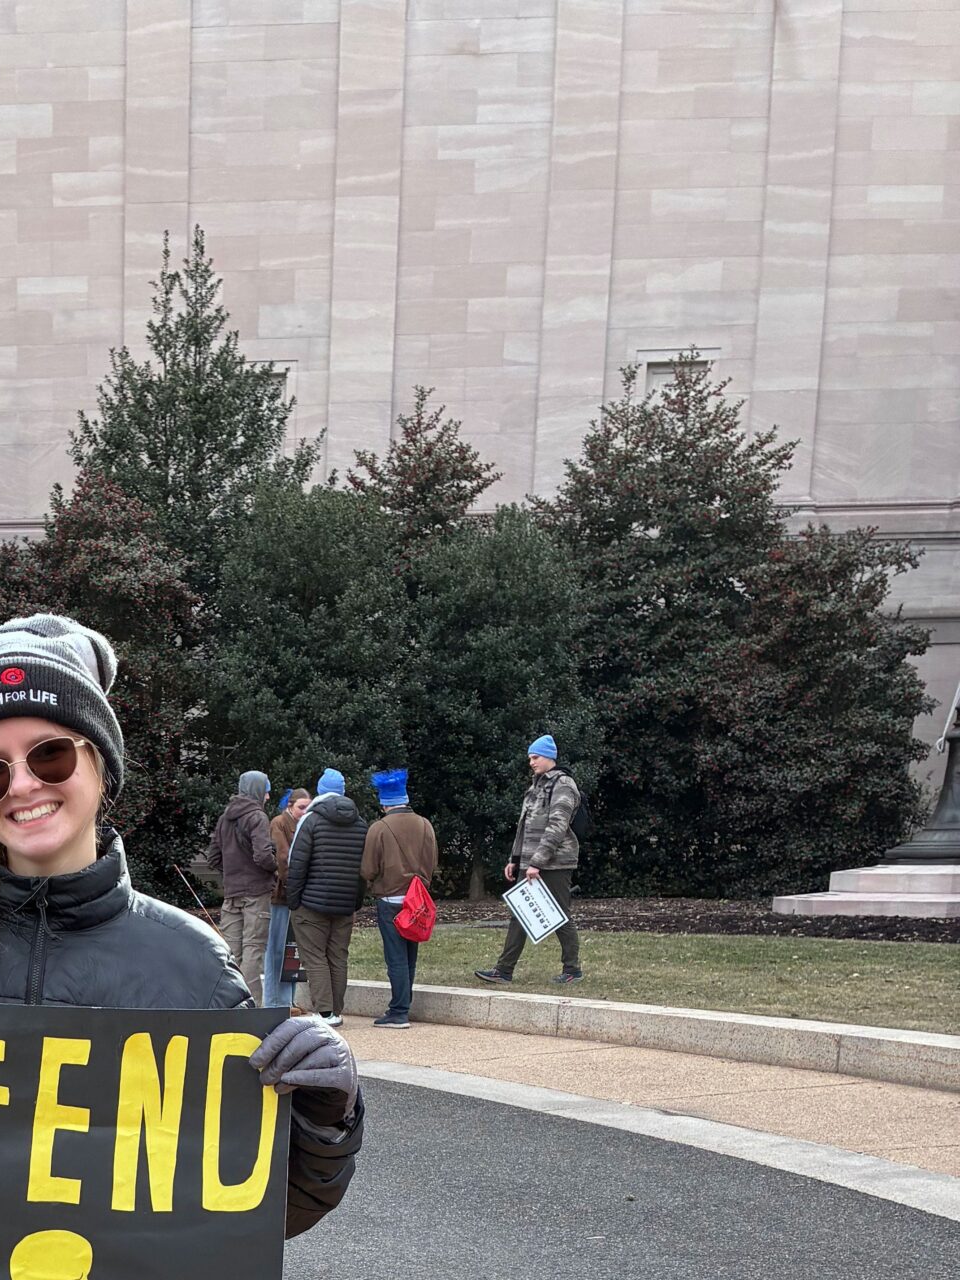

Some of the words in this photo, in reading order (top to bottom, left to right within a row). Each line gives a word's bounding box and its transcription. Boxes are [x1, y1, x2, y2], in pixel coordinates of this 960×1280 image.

[5, 691, 26, 703] FOR
[29, 689, 58, 706] LIFE
[519, 888, 549, 930] FREEDOM
